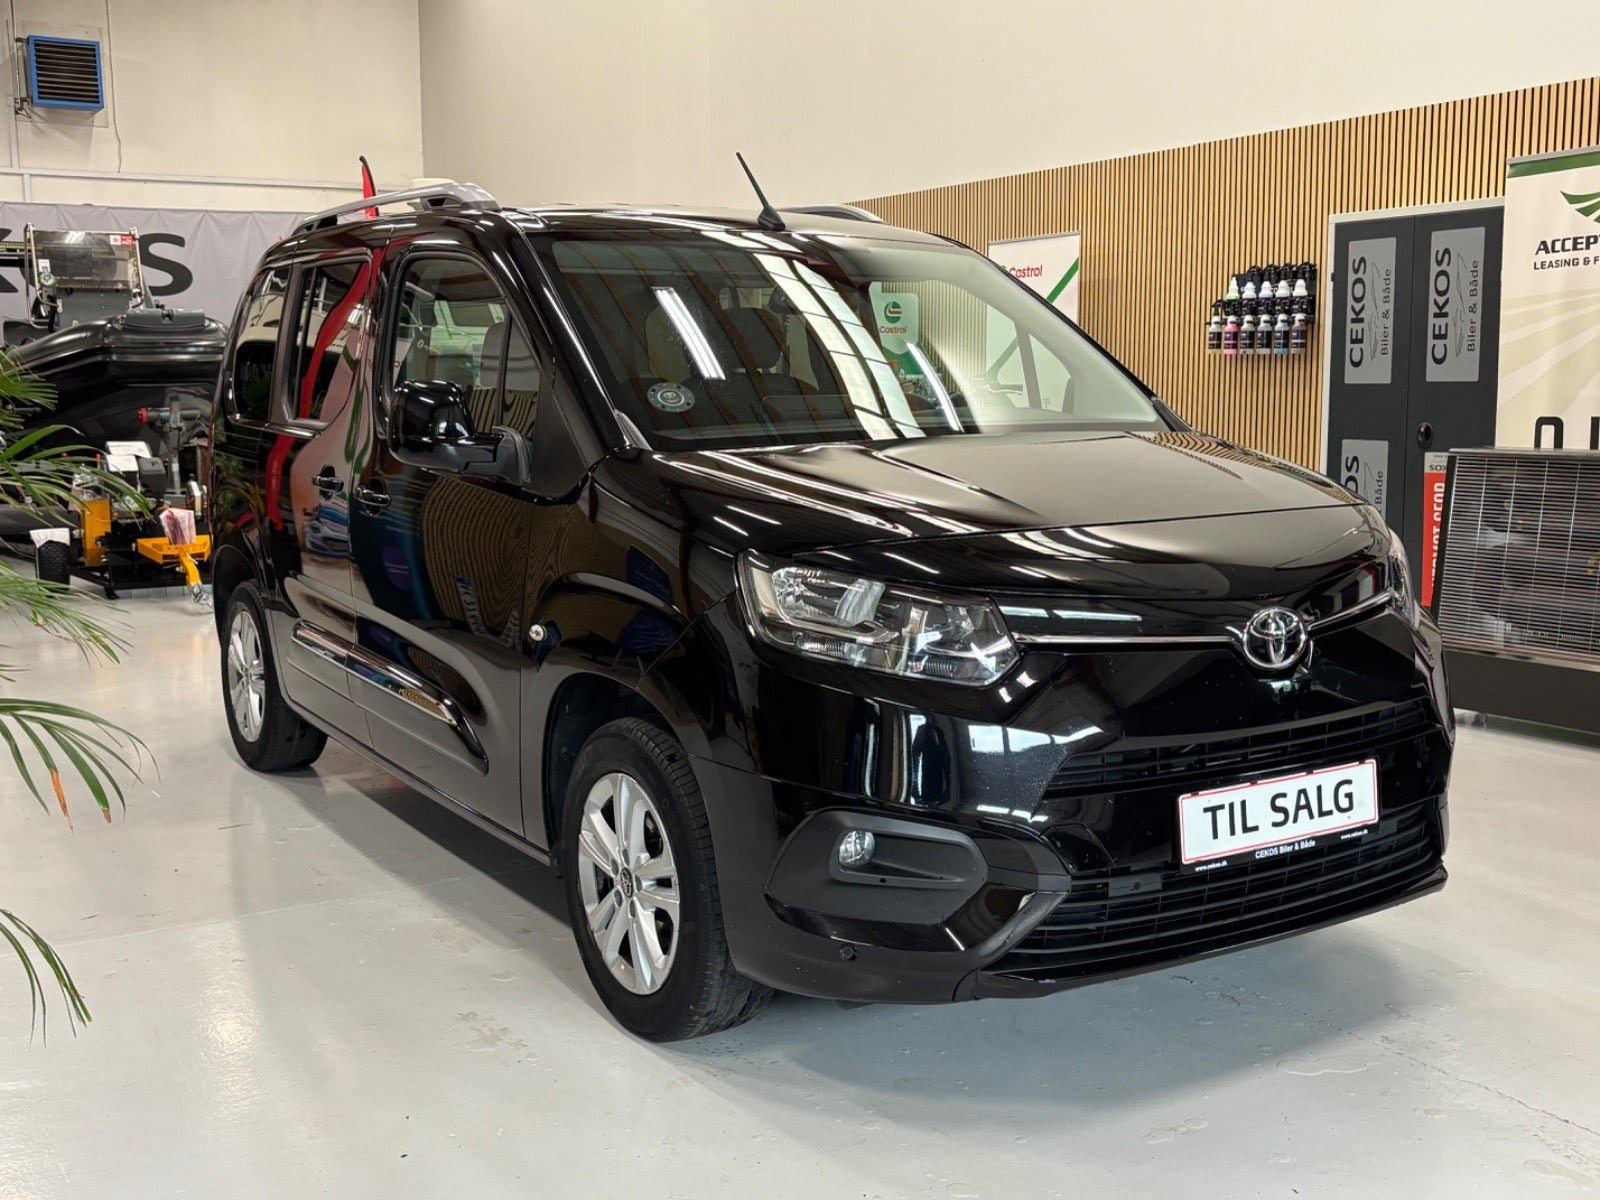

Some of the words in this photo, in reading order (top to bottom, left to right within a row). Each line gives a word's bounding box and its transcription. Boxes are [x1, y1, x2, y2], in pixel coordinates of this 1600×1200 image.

[1534, 233, 1600, 256] ACCEP
[1469, 260, 1479, 297] Både
[1533, 257, 1579, 271] LEASING
[1583, 256, 1592, 266] &
[1382, 268, 1391, 304] Både
[1350, 256, 1367, 368] CEKOS
[1382, 308, 1389, 320] &
[1431, 247, 1452, 365] CEKOS
[1469, 303, 1477, 314] &
[880, 325, 907, 334] Castrol
[1380, 323, 1389, 356] Biler
[1467, 320, 1477, 352] Biler
[1374, 470, 1384, 505] Både
[1203, 799, 1259, 840] TIL
[1270, 779, 1354, 828] SALG
[1255, 847, 1278, 859] CEKOS
